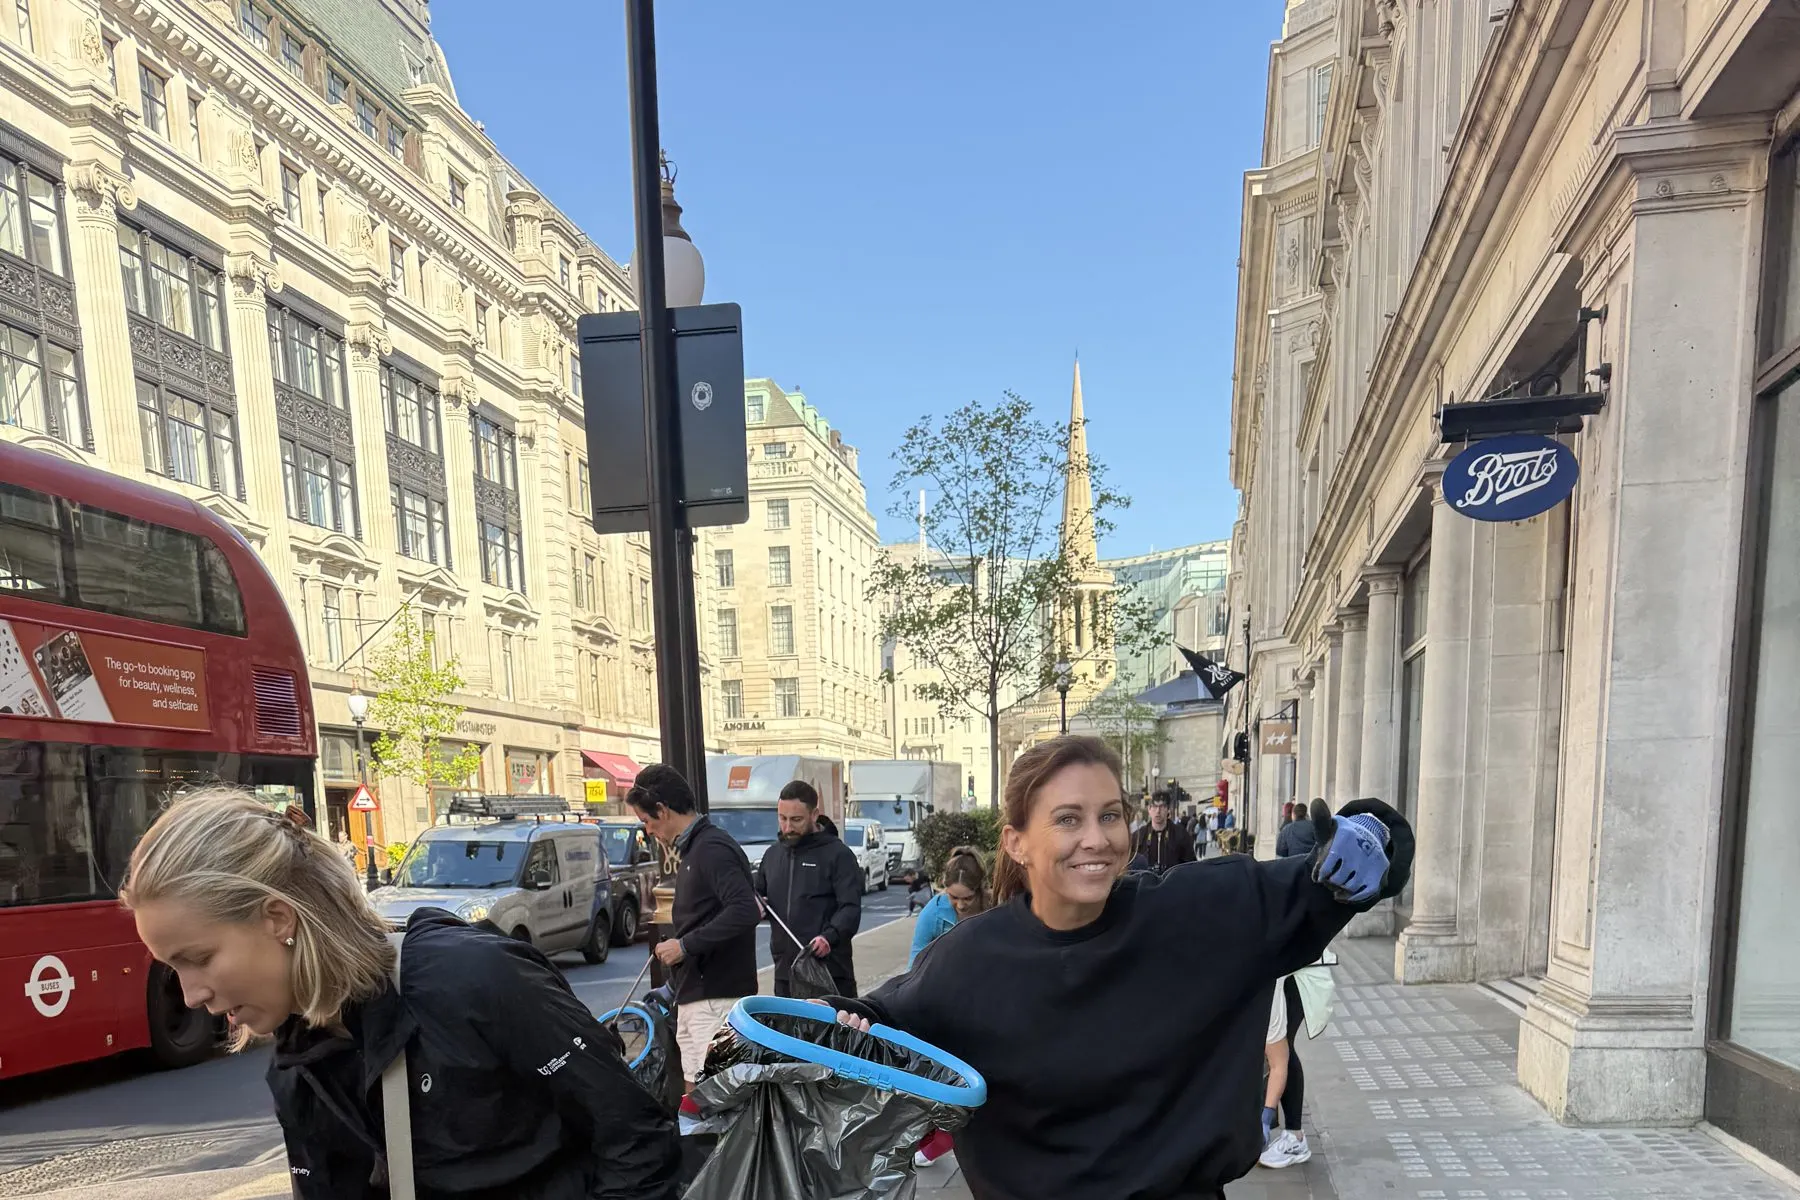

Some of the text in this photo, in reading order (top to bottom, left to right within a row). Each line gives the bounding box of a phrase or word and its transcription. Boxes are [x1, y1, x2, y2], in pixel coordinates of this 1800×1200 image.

[1456, 447, 1558, 508] Boots
[104, 656, 196, 682] The go-to booking app
[118, 675, 197, 698] for beauty, wellness,
[152, 697, 199, 712] and selfcare
[41, 981, 60, 992] BUSES
